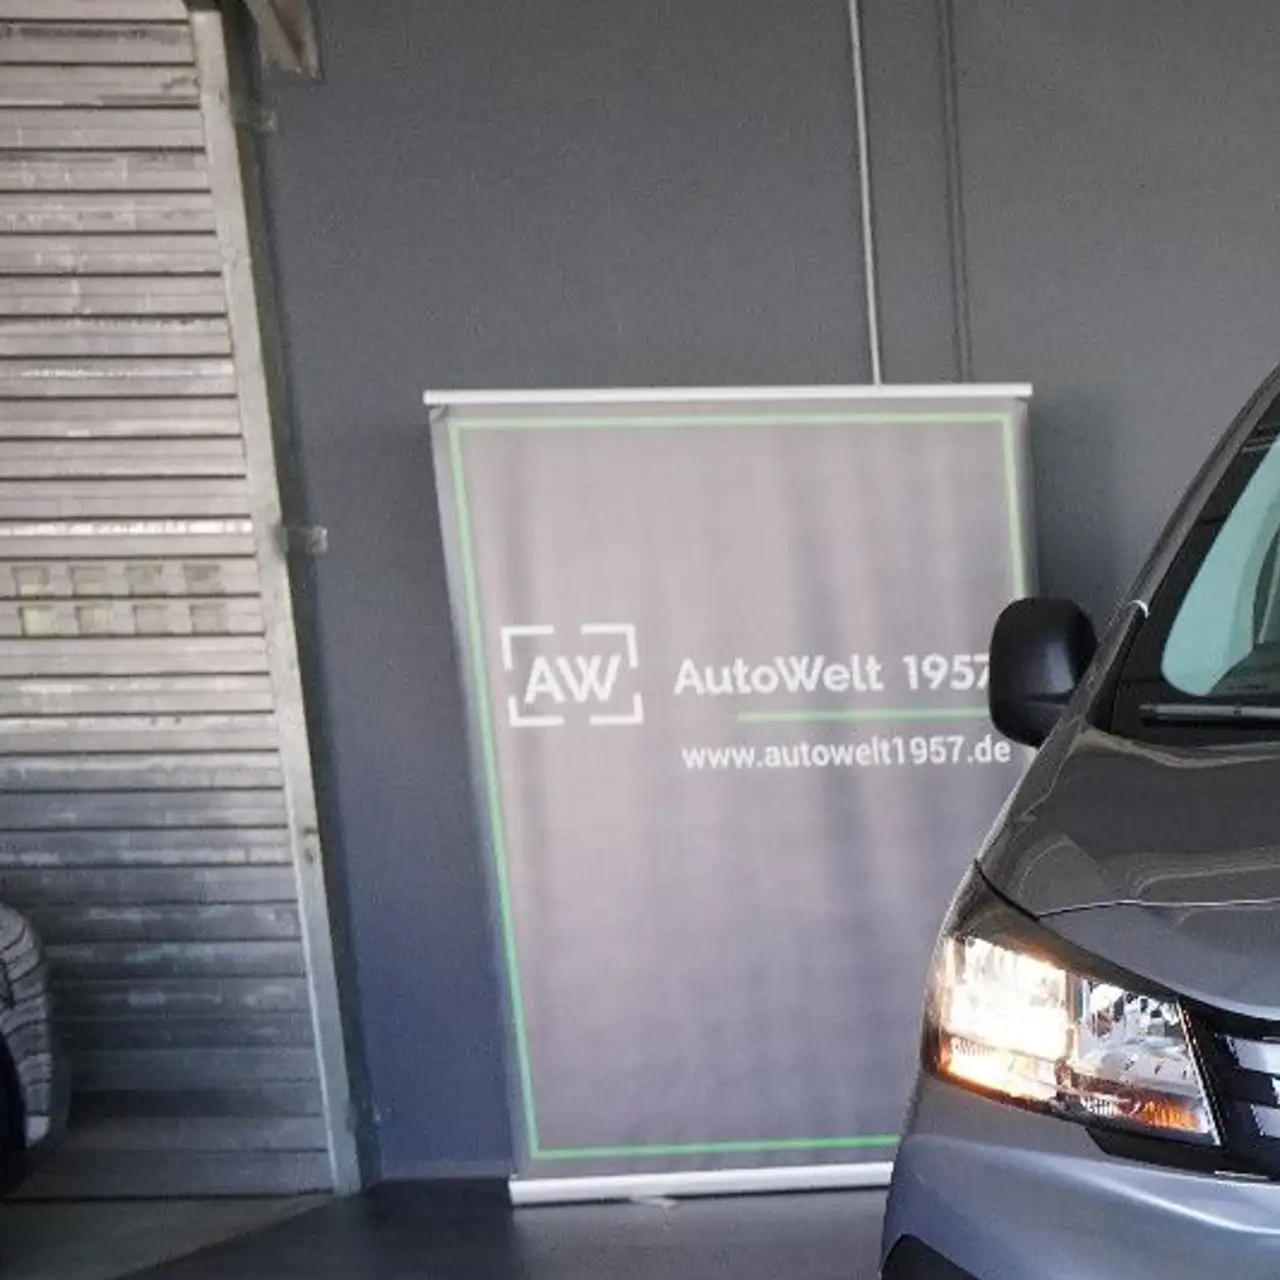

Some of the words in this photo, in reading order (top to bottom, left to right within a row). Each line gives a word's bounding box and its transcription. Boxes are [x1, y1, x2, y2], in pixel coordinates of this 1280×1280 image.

[524, 655, 621, 704] AW
[674, 653, 884, 695] AutoWelt
[902, 653, 990, 690] 1957
[682, 734, 1012, 770] www.autowelt1957.de
